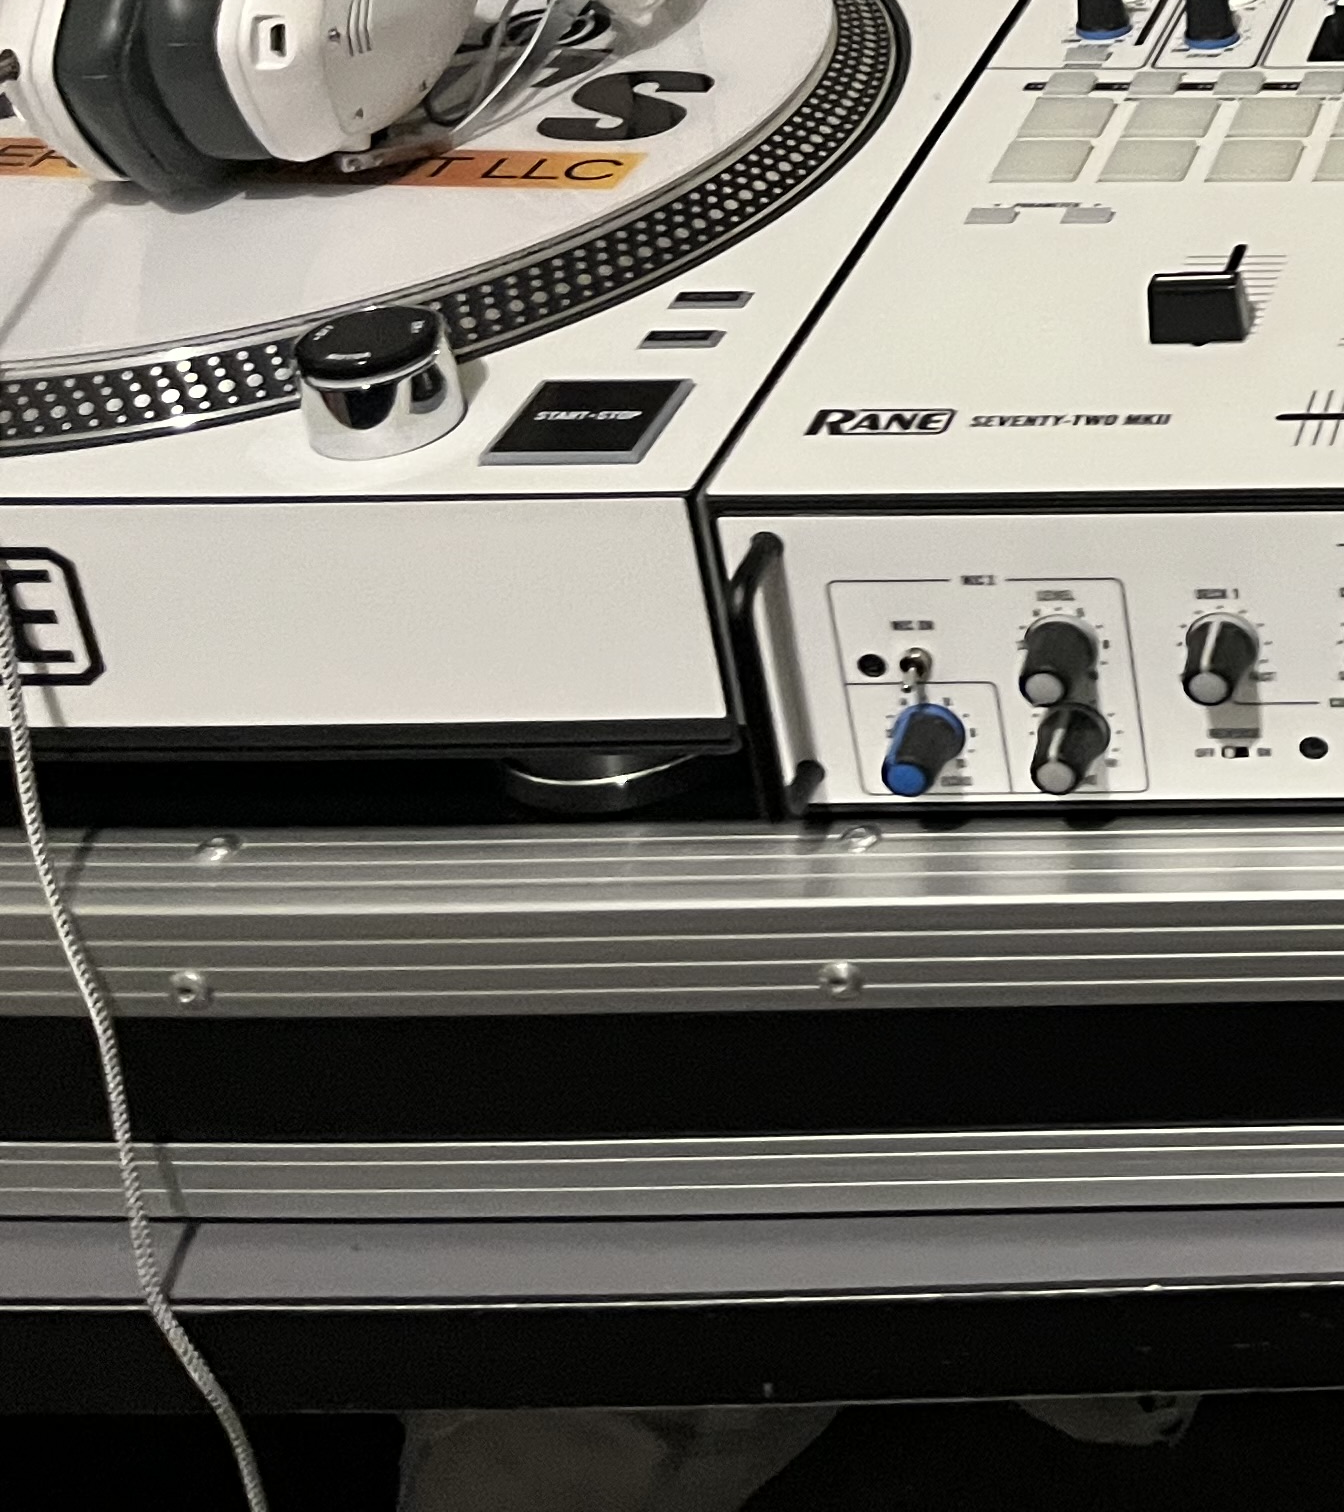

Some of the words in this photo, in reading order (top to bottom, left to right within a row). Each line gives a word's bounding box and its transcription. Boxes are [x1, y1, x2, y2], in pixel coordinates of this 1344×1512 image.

[481, 158, 624, 180] LLC
[803, 408, 957, 436] RANE
[969, 414, 1118, 428] SEVENTY-TWO
